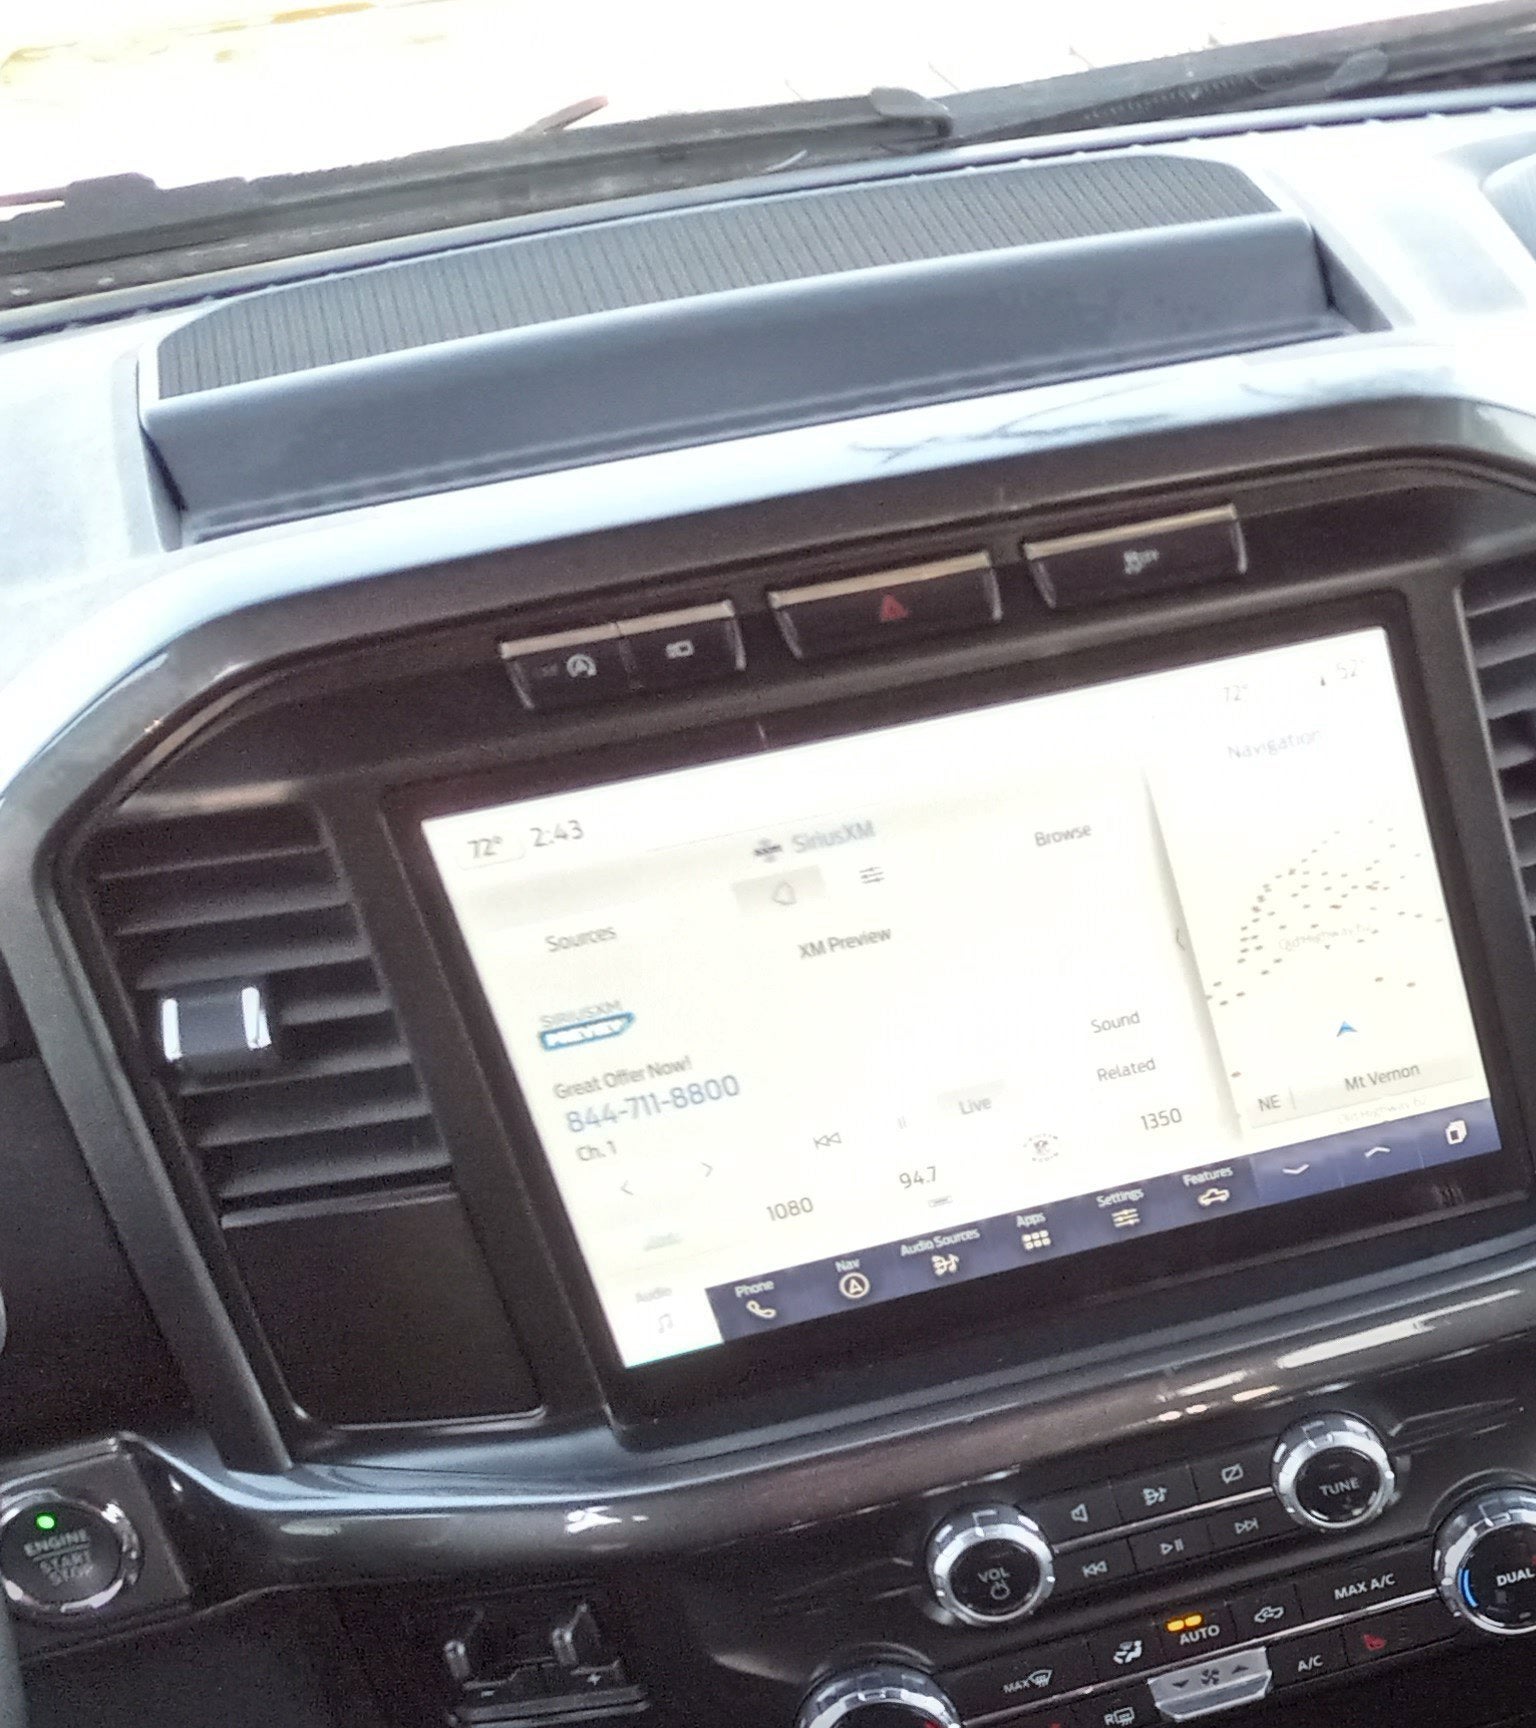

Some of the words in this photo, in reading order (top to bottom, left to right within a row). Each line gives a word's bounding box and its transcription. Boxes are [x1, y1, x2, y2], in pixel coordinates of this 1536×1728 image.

[529, 819, 584, 848] 2:43
[1034, 823, 1092, 848] Browse
[544, 926, 618, 953] Sources
[799, 940, 827, 959] XM
[827, 928, 892, 953] Preview
[1090, 1010, 1142, 1034] Sound
[552, 1076, 602, 1100] Great
[602, 1068, 647, 1089] Offer
[648, 1055, 693, 1079] Now!
[1096, 1057, 1158, 1082] Related
[1343, 1074, 1366, 1092] Mt
[1368, 1063, 1421, 1086] Vernon
[566, 1075, 740, 1133] 844-711-8800
[957, 1097, 993, 1116] Live
[1257, 1094, 1282, 1113] NE
[1140, 1107, 1183, 1131] 1350
[898, 1165, 938, 1190] 94.7
[1181, 1164, 1235, 1190] Features
[766, 1196, 815, 1223] 1080
[1095, 1187, 1145, 1210] Settings
[1015, 1210, 1047, 1230] Apps
[899, 1240, 930, 1258] Audio
[931, 1228, 981, 1251] Sources
[834, 1258, 861, 1273] Nav
[734, 1277, 775, 1299] Phone
[1319, 1477, 1361, 1497] TUNE
[978, 1565, 1011, 1583] VOL
[1495, 1567, 1536, 1587] DUAL
[1333, 1581, 1367, 1601] MAX
[1370, 1573, 1396, 1593] A/C
[1179, 1624, 1220, 1646] AUTO
[1297, 1654, 1324, 1673] A/C
[1003, 1678, 1031, 1694] MAX
